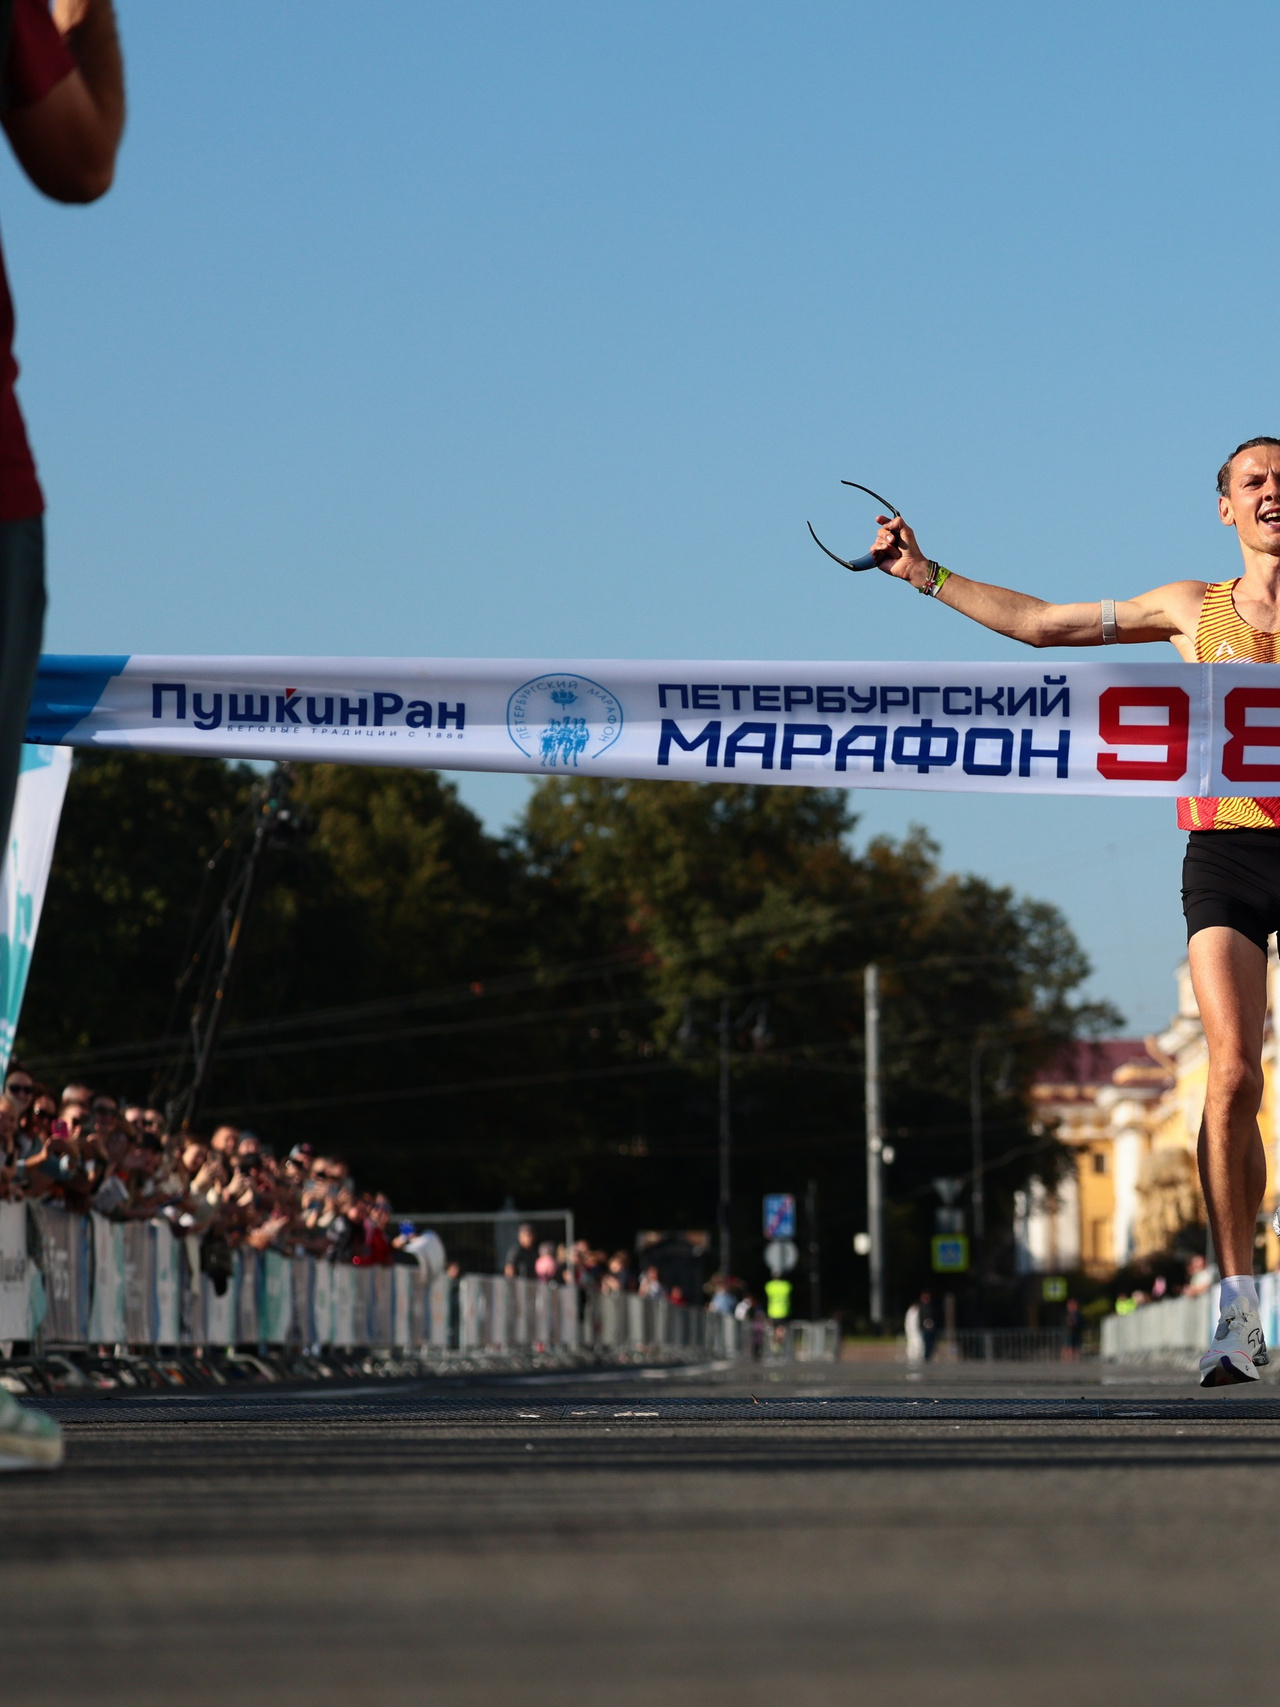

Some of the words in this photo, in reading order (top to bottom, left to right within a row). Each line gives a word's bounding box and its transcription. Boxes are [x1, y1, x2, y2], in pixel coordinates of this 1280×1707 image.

[152, 683, 466, 731] ПушкинРан
[513, 680, 579, 740] ПЕТЕРБУРГСКИЙ
[586, 688, 618, 743] МАРАФОН
[657, 675, 1070, 718] ПЕТЕРБУРГСКИЙ
[227, 724, 300, 735] БЕГОВЫЕ
[311, 727, 398, 738] ТРАДИЦИИ
[427, 732, 464, 740] 1888
[656, 718, 1070, 779] МАРАФОН
